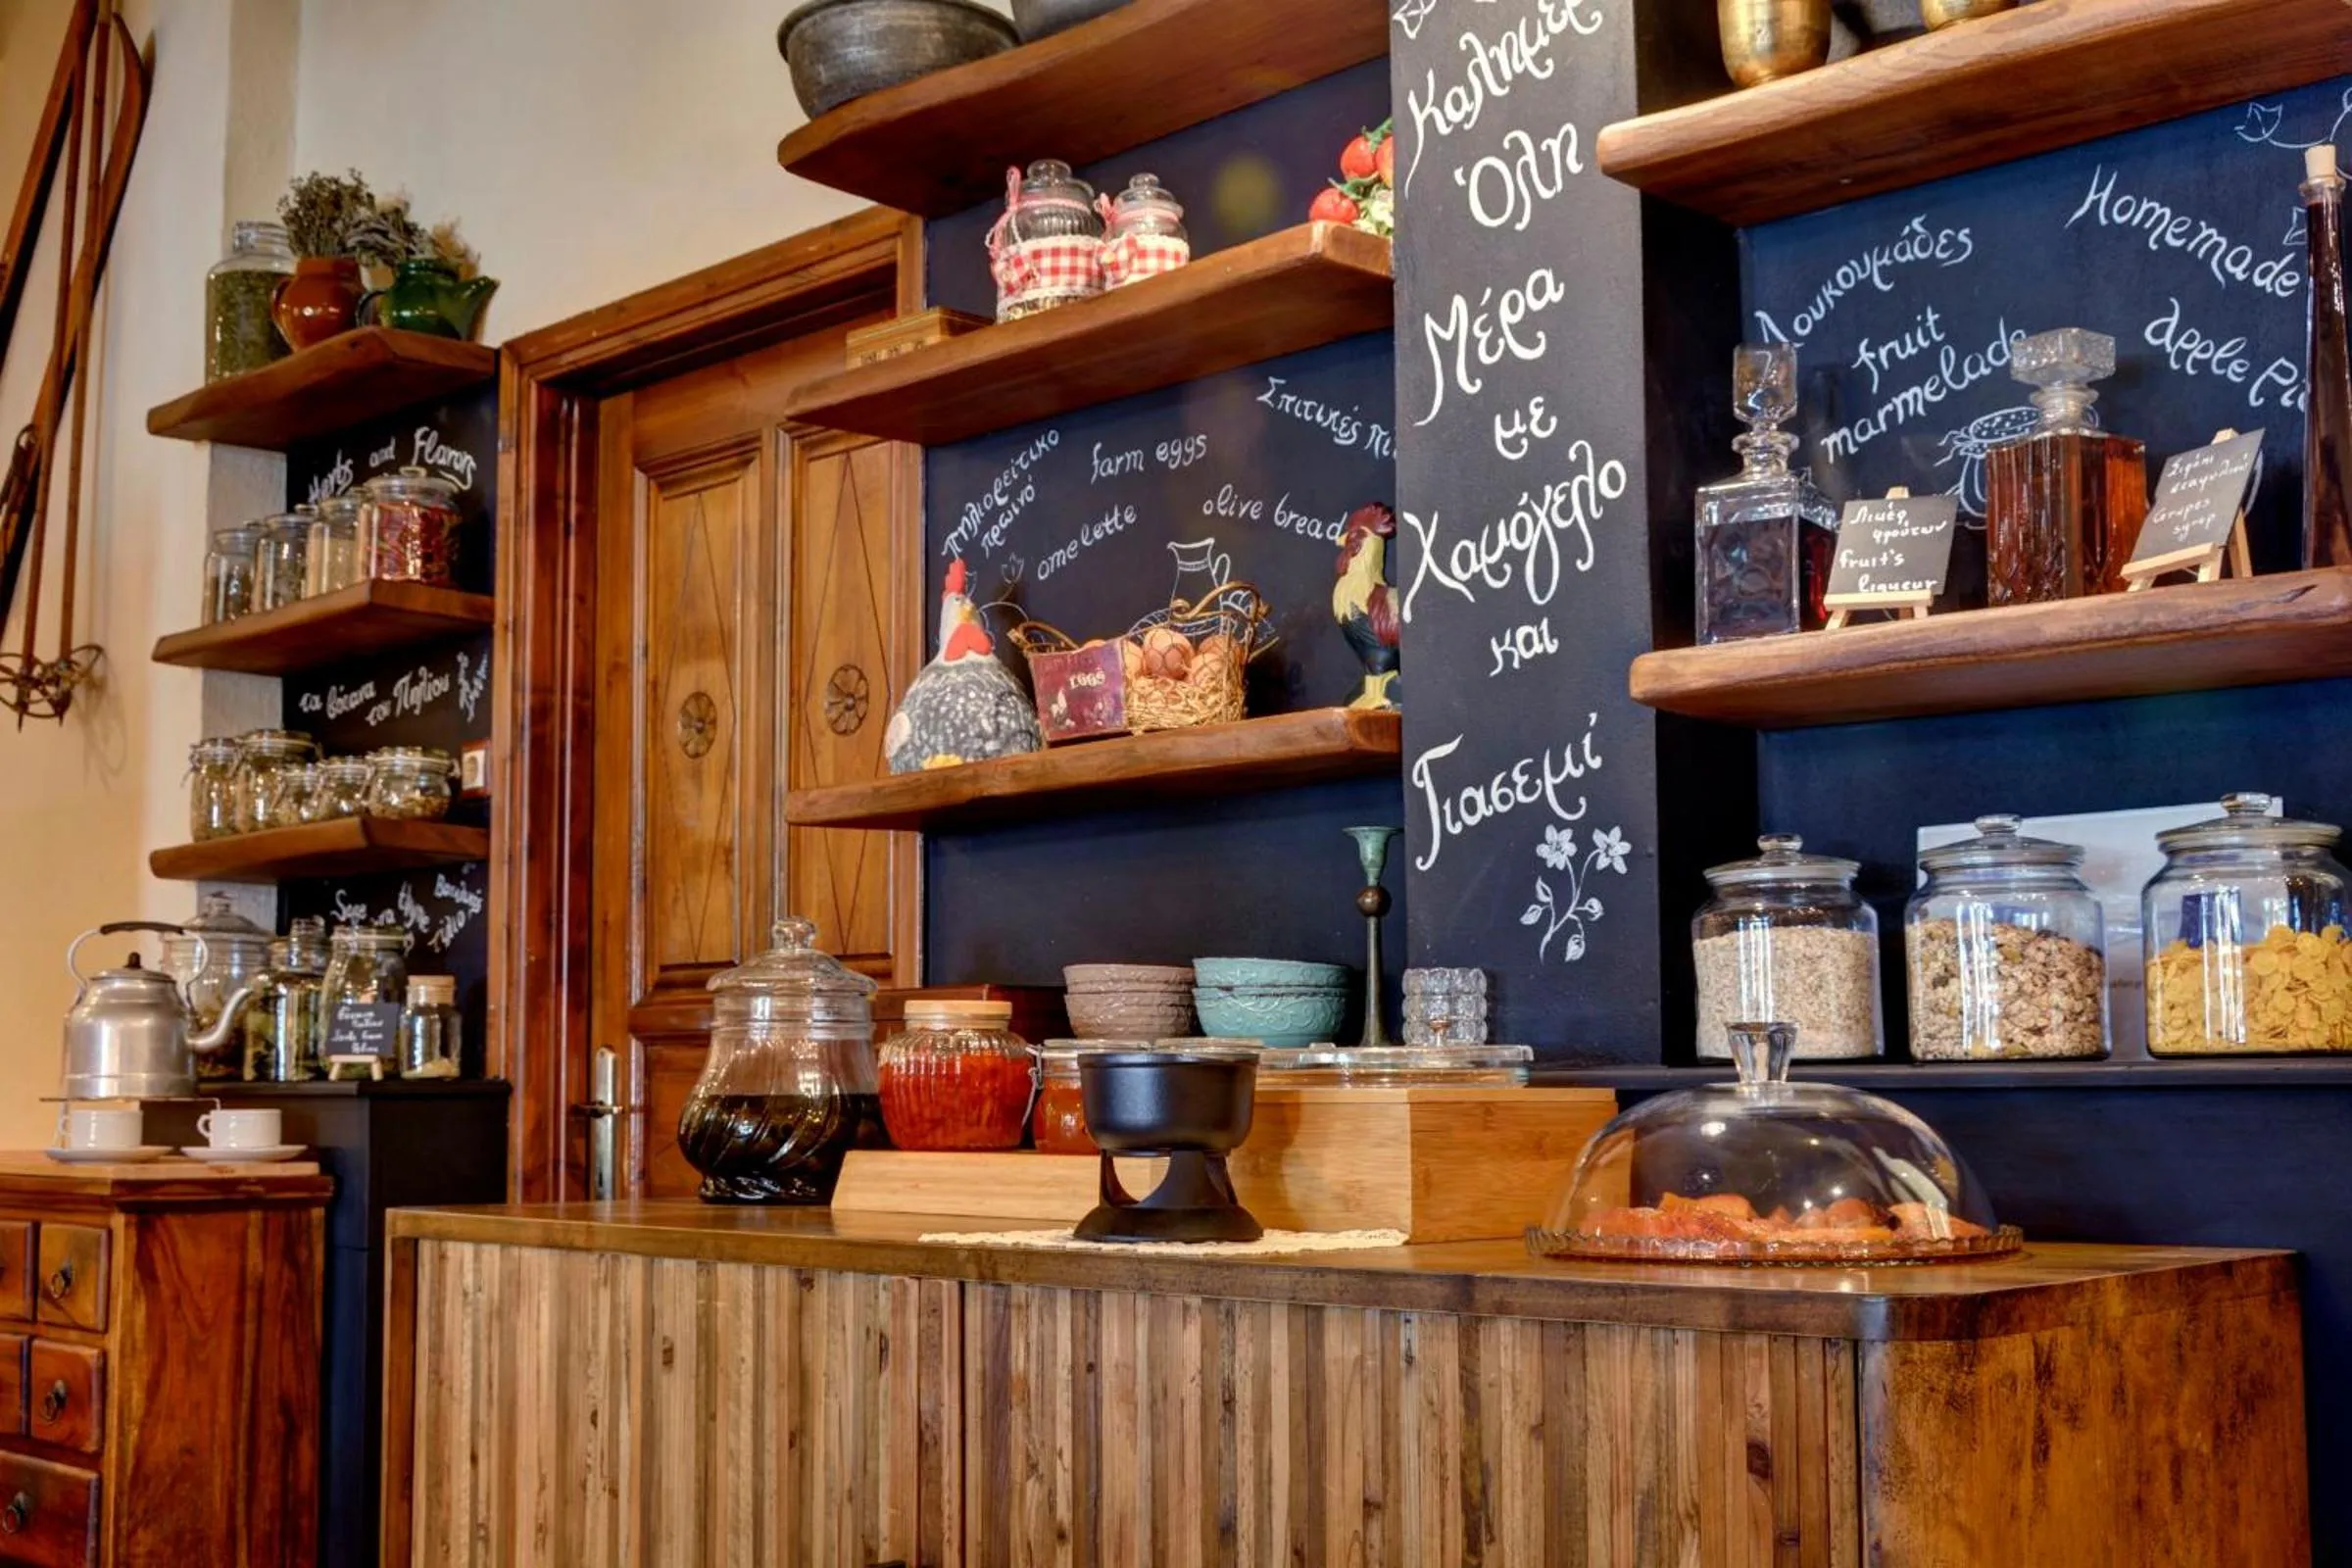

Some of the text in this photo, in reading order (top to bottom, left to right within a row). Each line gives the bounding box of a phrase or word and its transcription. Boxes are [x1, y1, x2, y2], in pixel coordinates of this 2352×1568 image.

[2065, 164, 2300, 297] Homemade
[1851, 305, 1945, 394] fruit
[368, 436, 396, 467] and
[1091, 433, 1208, 484] farm eggs
[1037, 503, 1138, 581] omelette
[1202, 484, 1348, 541] olive bread
[1490, 616, 1559, 677] και
